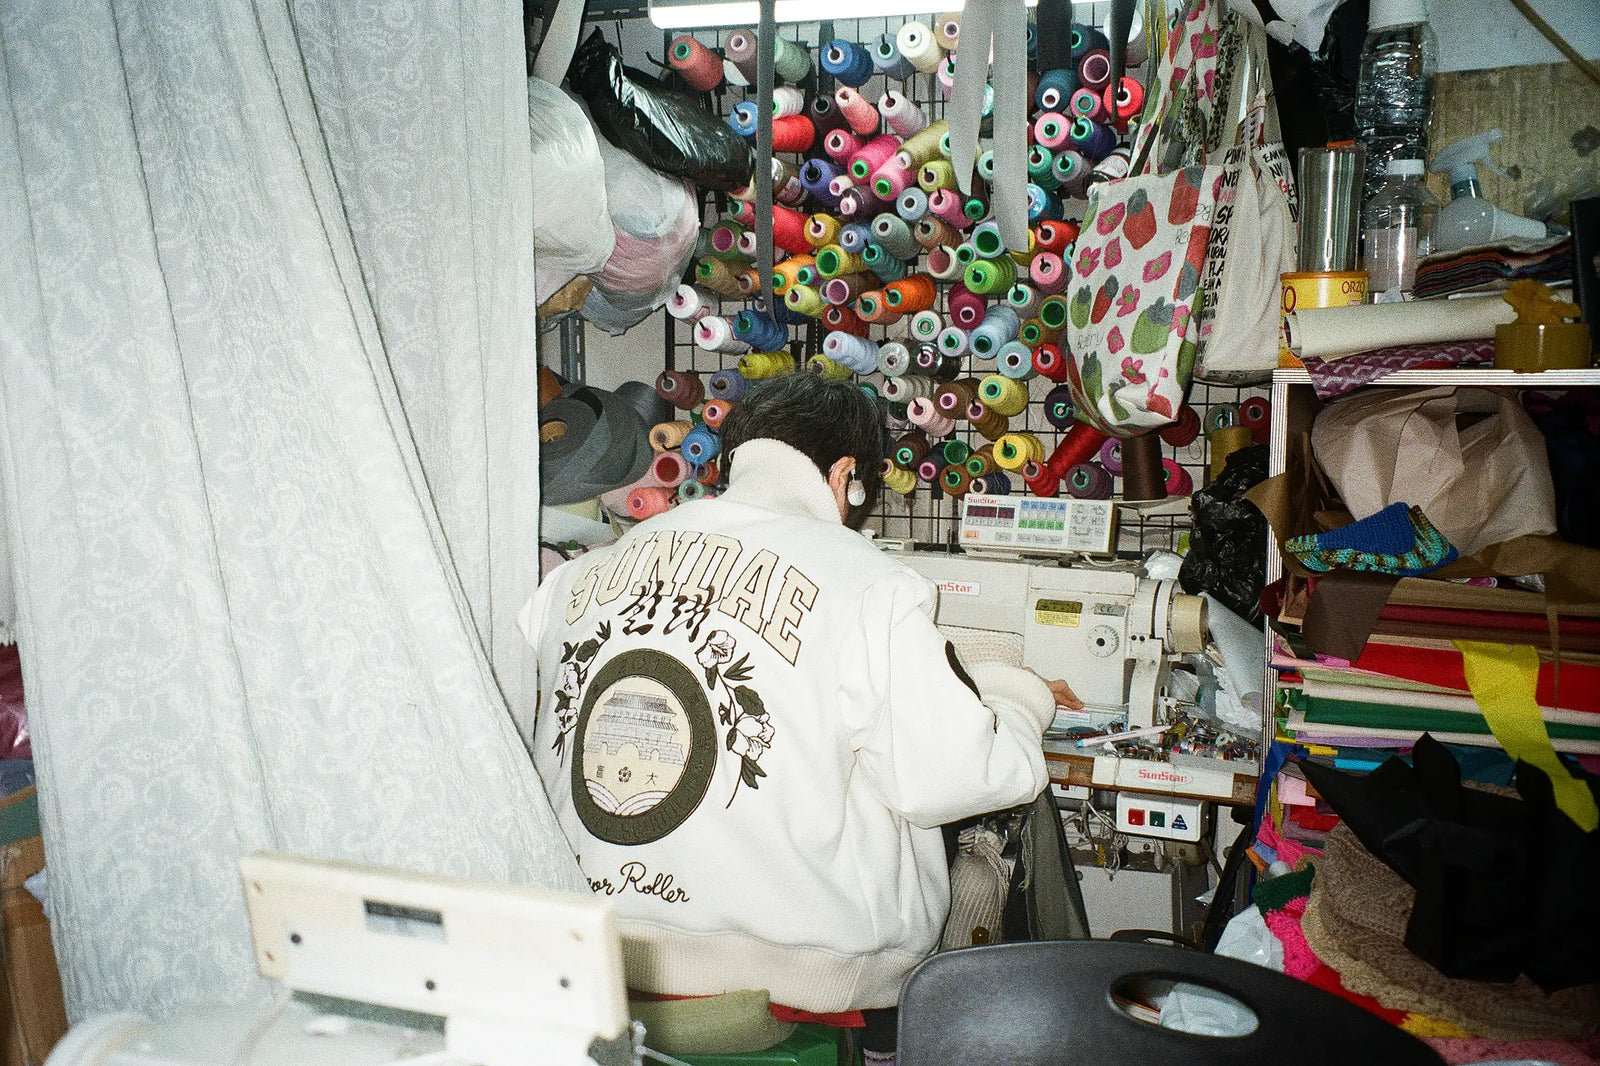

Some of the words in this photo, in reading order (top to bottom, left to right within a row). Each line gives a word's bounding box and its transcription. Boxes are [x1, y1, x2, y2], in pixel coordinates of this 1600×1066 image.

[1341, 280, 1366, 295] ORZO
[967, 496, 999, 505] SunStar
[565, 530, 820, 667] SUNDAE
[1137, 768, 1188, 783] SunStar
[617, 861, 691, 903] Roller
